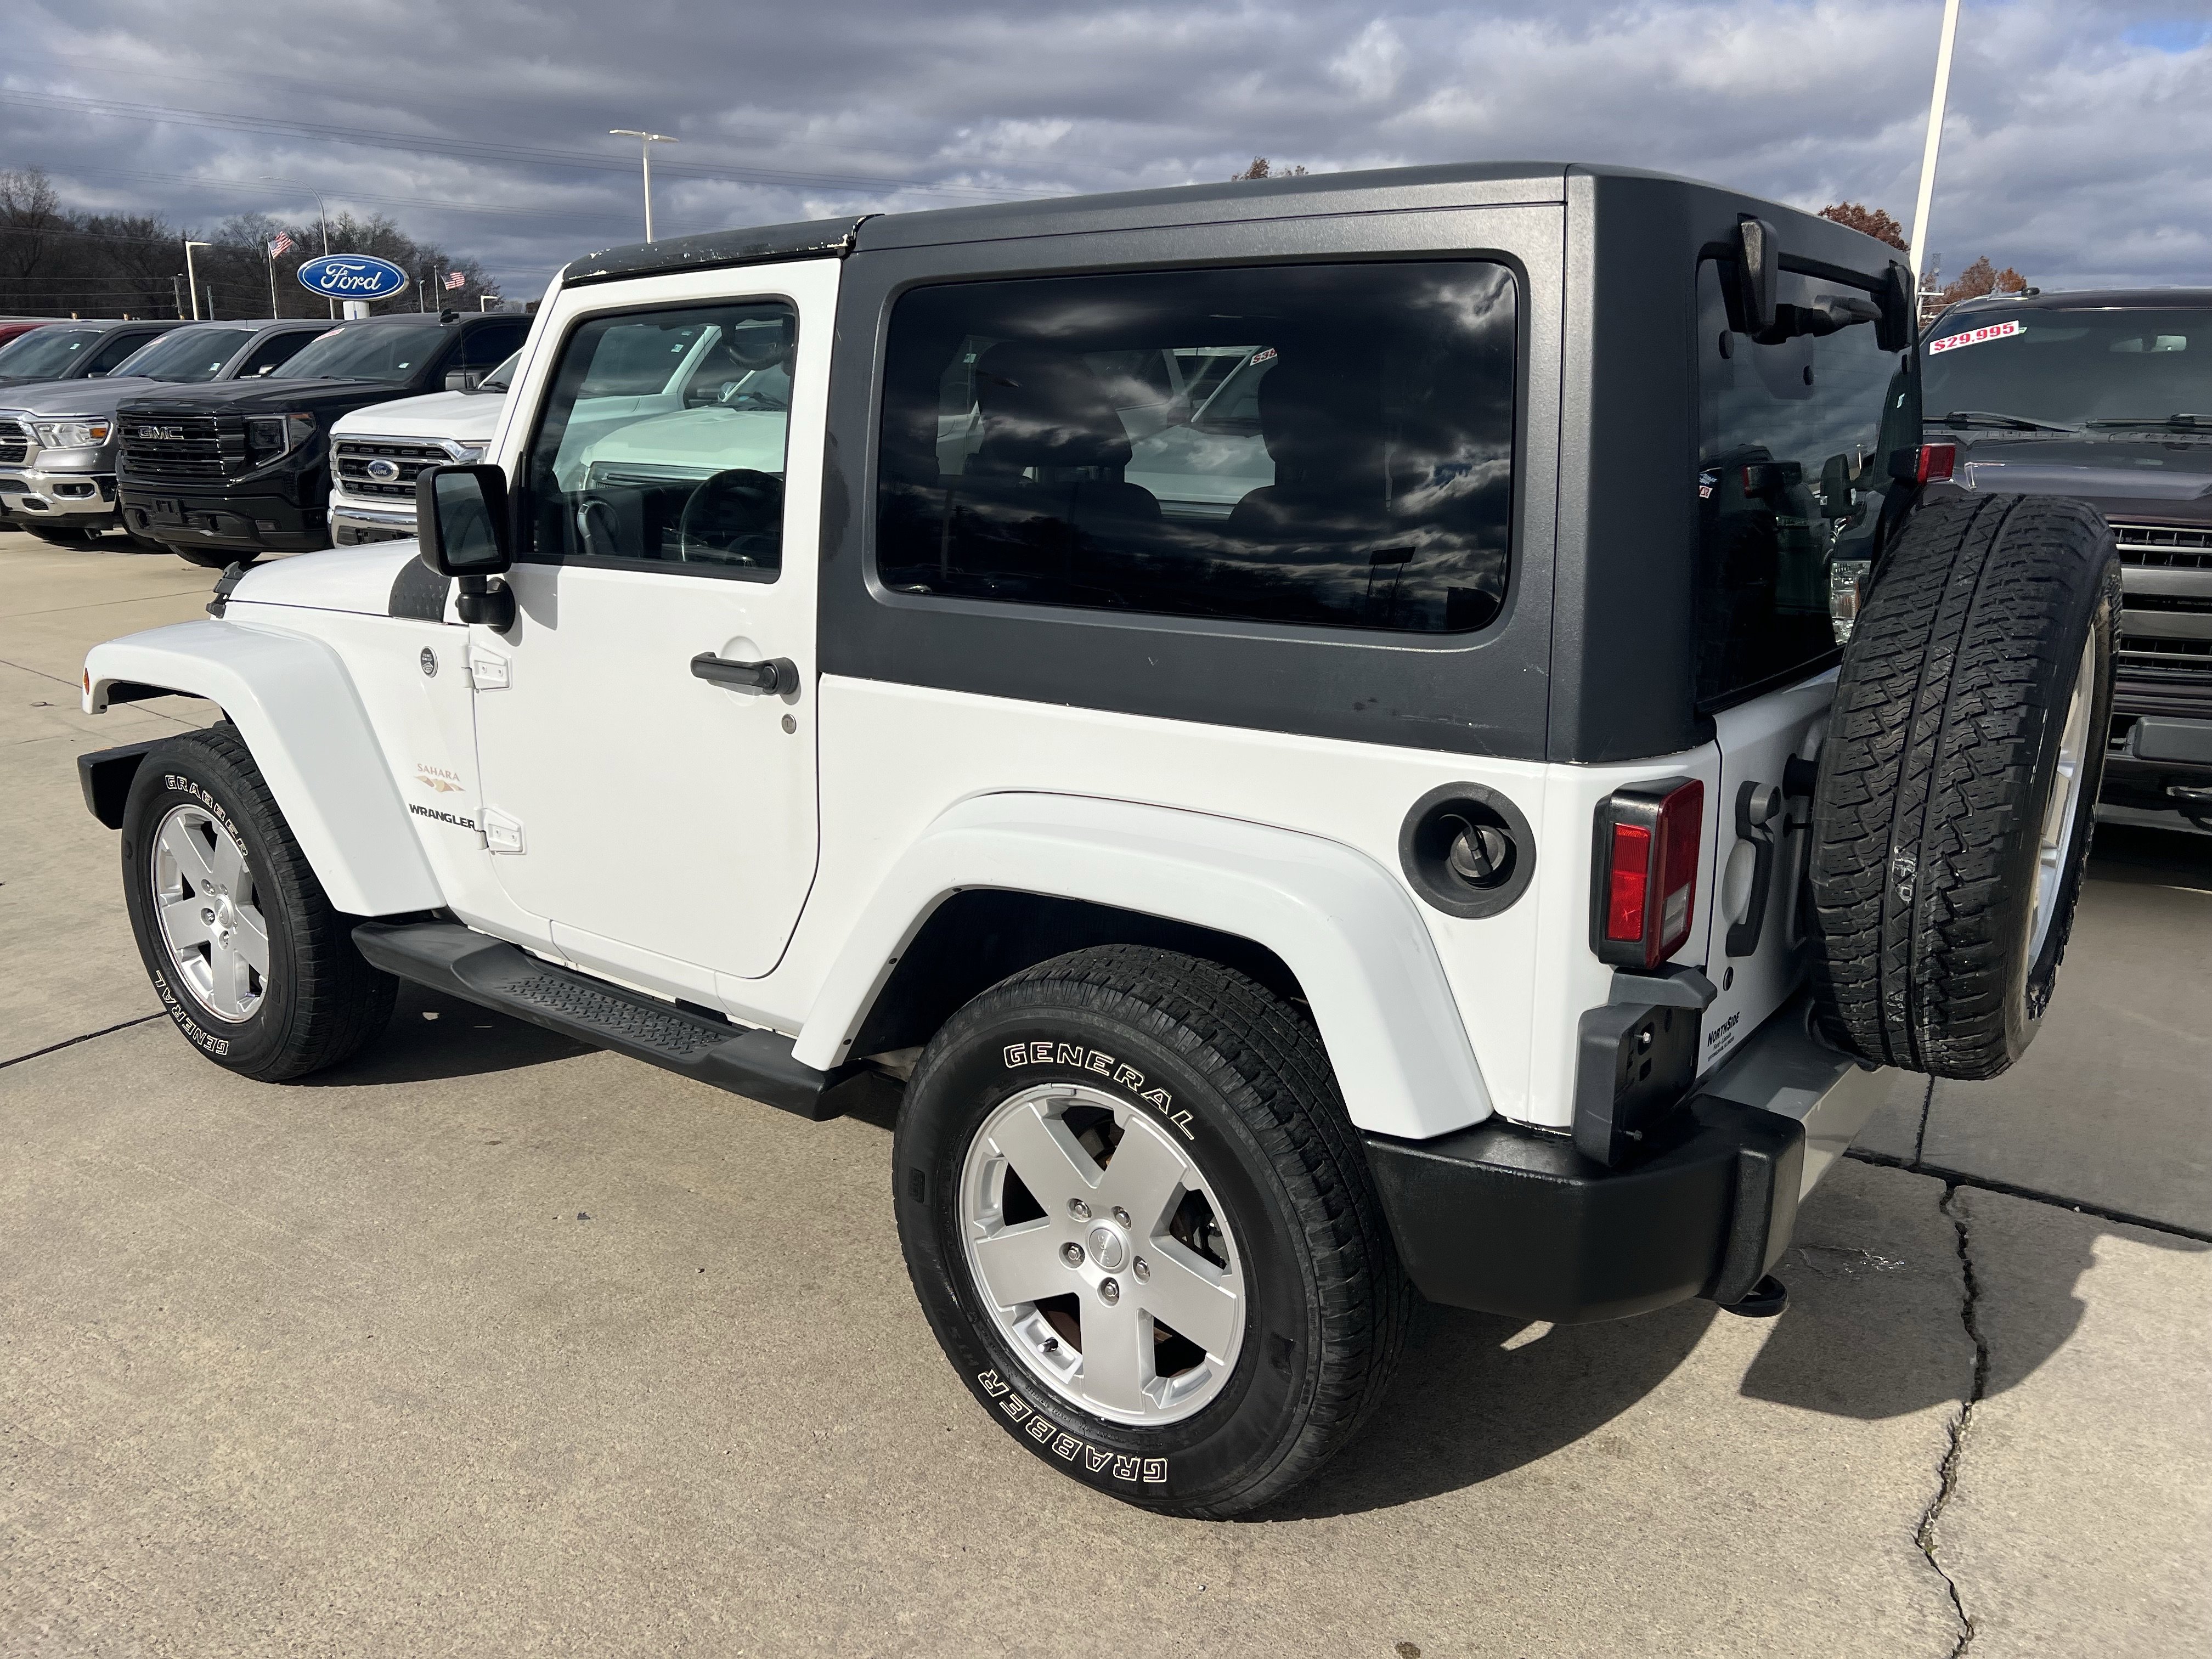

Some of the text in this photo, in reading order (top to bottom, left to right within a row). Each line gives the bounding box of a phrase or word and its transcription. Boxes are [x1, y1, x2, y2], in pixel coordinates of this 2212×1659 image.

[320, 263, 382, 290] Ford
[1934, 323, 2015, 351] $29,995
[138, 425, 185, 440] GMC
[417, 763, 460, 782] SAHARA
[165, 775, 249, 856] GRABBER
[409, 803, 475, 830] WRANGLER
[154, 969, 229, 1056] GENERAL
[1003, 1042, 1195, 1141] GENERAL
[978, 1369, 1167, 1482] GRABBER
